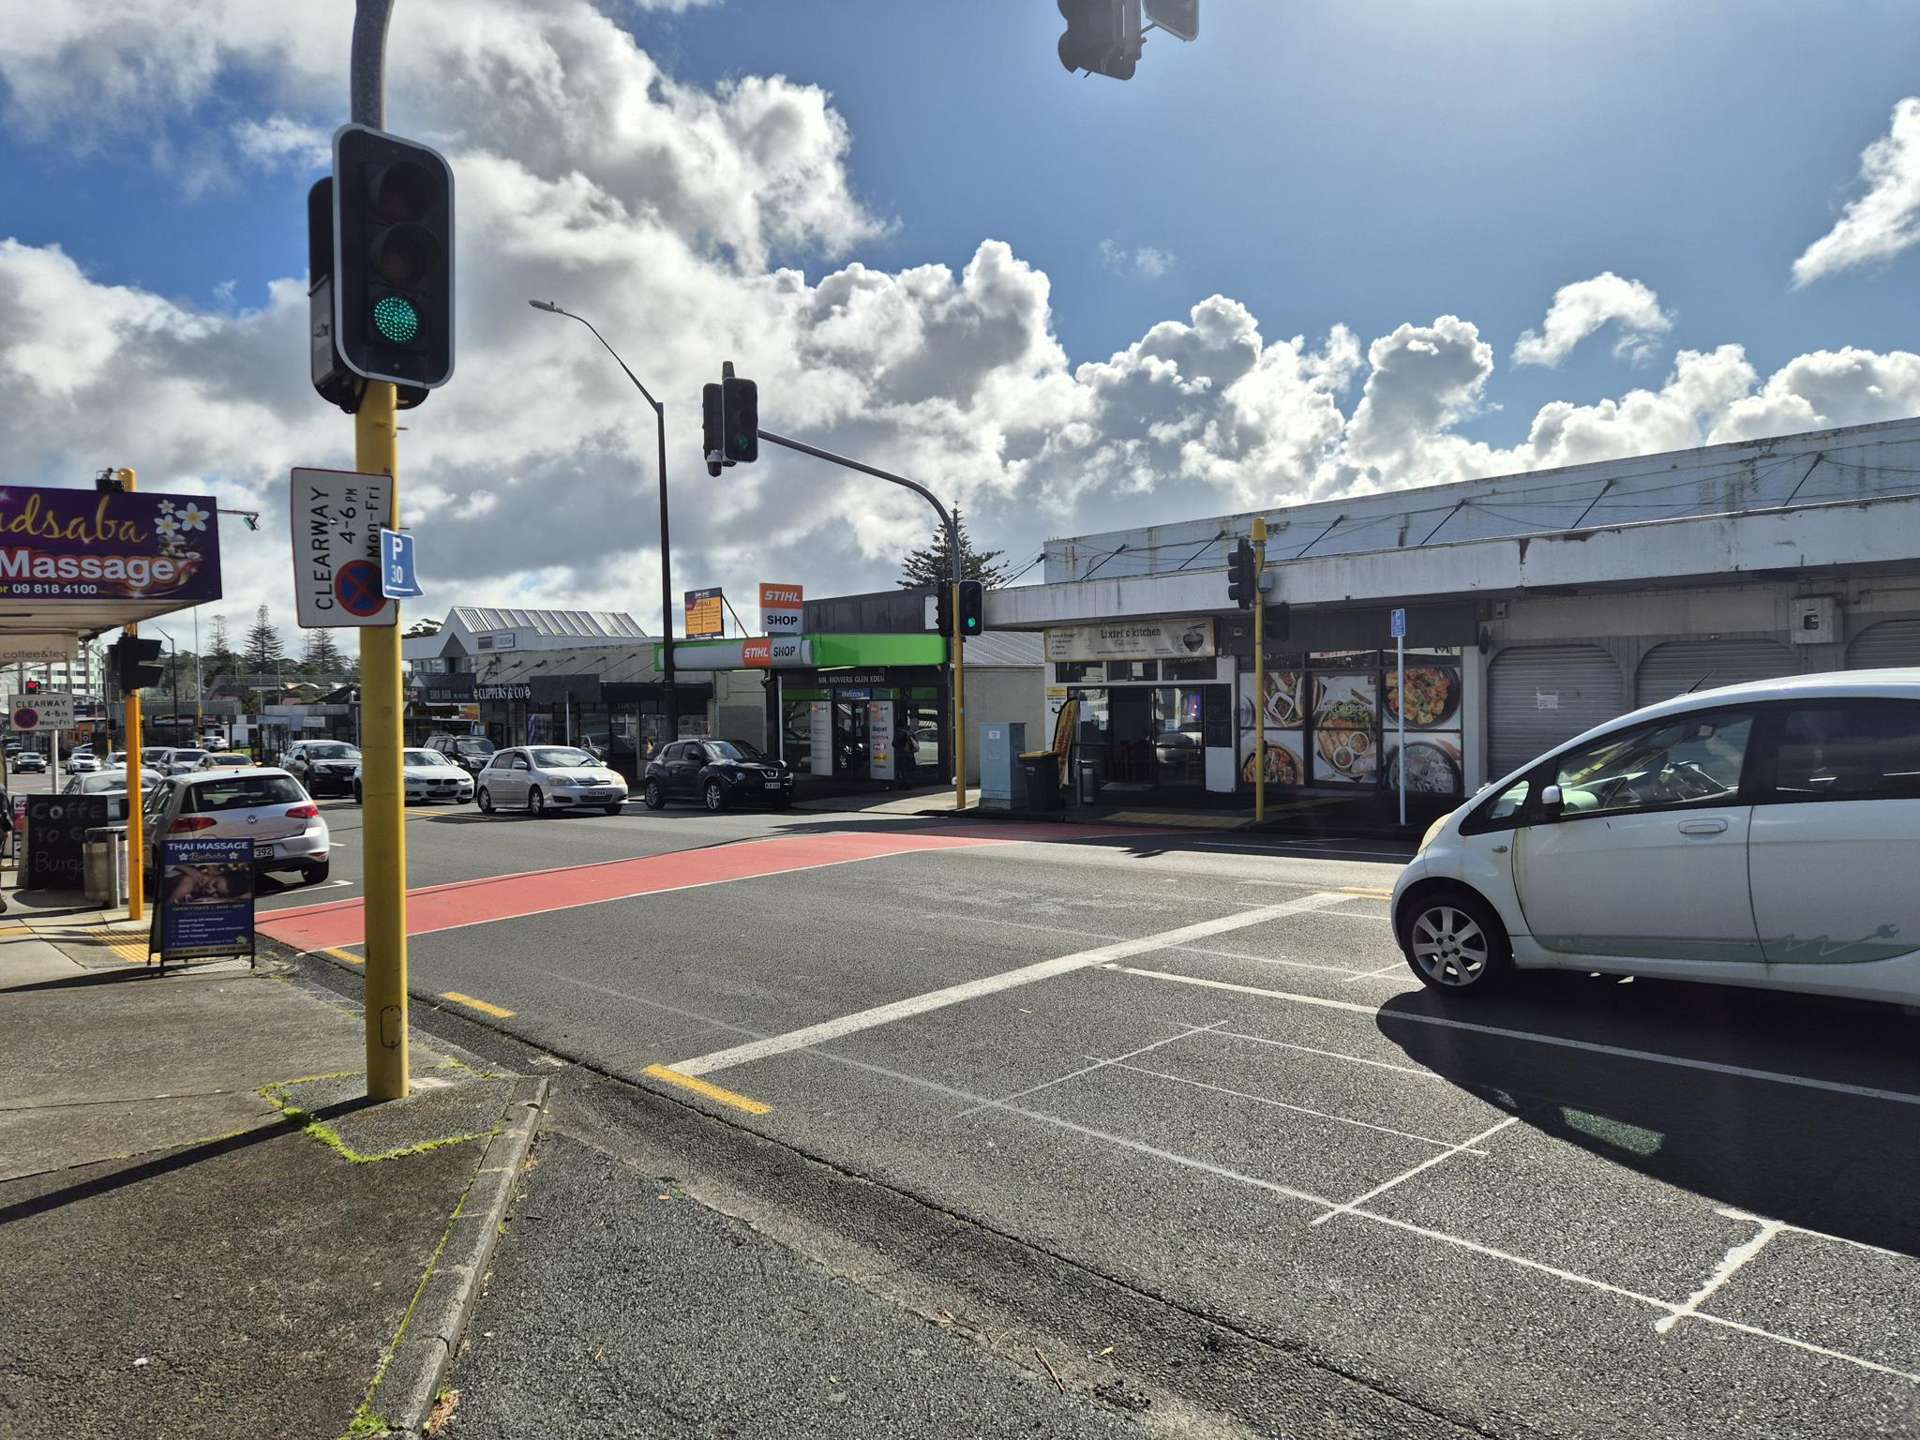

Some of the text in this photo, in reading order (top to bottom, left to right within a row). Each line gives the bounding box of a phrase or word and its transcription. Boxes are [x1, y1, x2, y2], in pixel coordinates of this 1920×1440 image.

[365, 486, 381, 558] Mon-Fri
[310, 487, 334, 610] CLEARWAY
[392, 537, 404, 561] P
[0, 550, 176, 587] Massage
[391, 564, 404, 584] 30
[12, 583, 30, 594] 09
[33, 583, 59, 594] 818
[64, 583, 97, 594] 4100
[764, 590, 801, 601] STIHL
[767, 615, 798, 626] SHOP
[744, 646, 796, 658] STIHL SHOP
[854, 675, 869, 683] GLEN
[478, 687, 507, 700] CLIPPERS
[507, 687, 514, 699] &
[514, 687, 525, 699] CO
[16, 700, 66, 708] CLEARWAY
[168, 841, 248, 851] THAI MASSAGE
